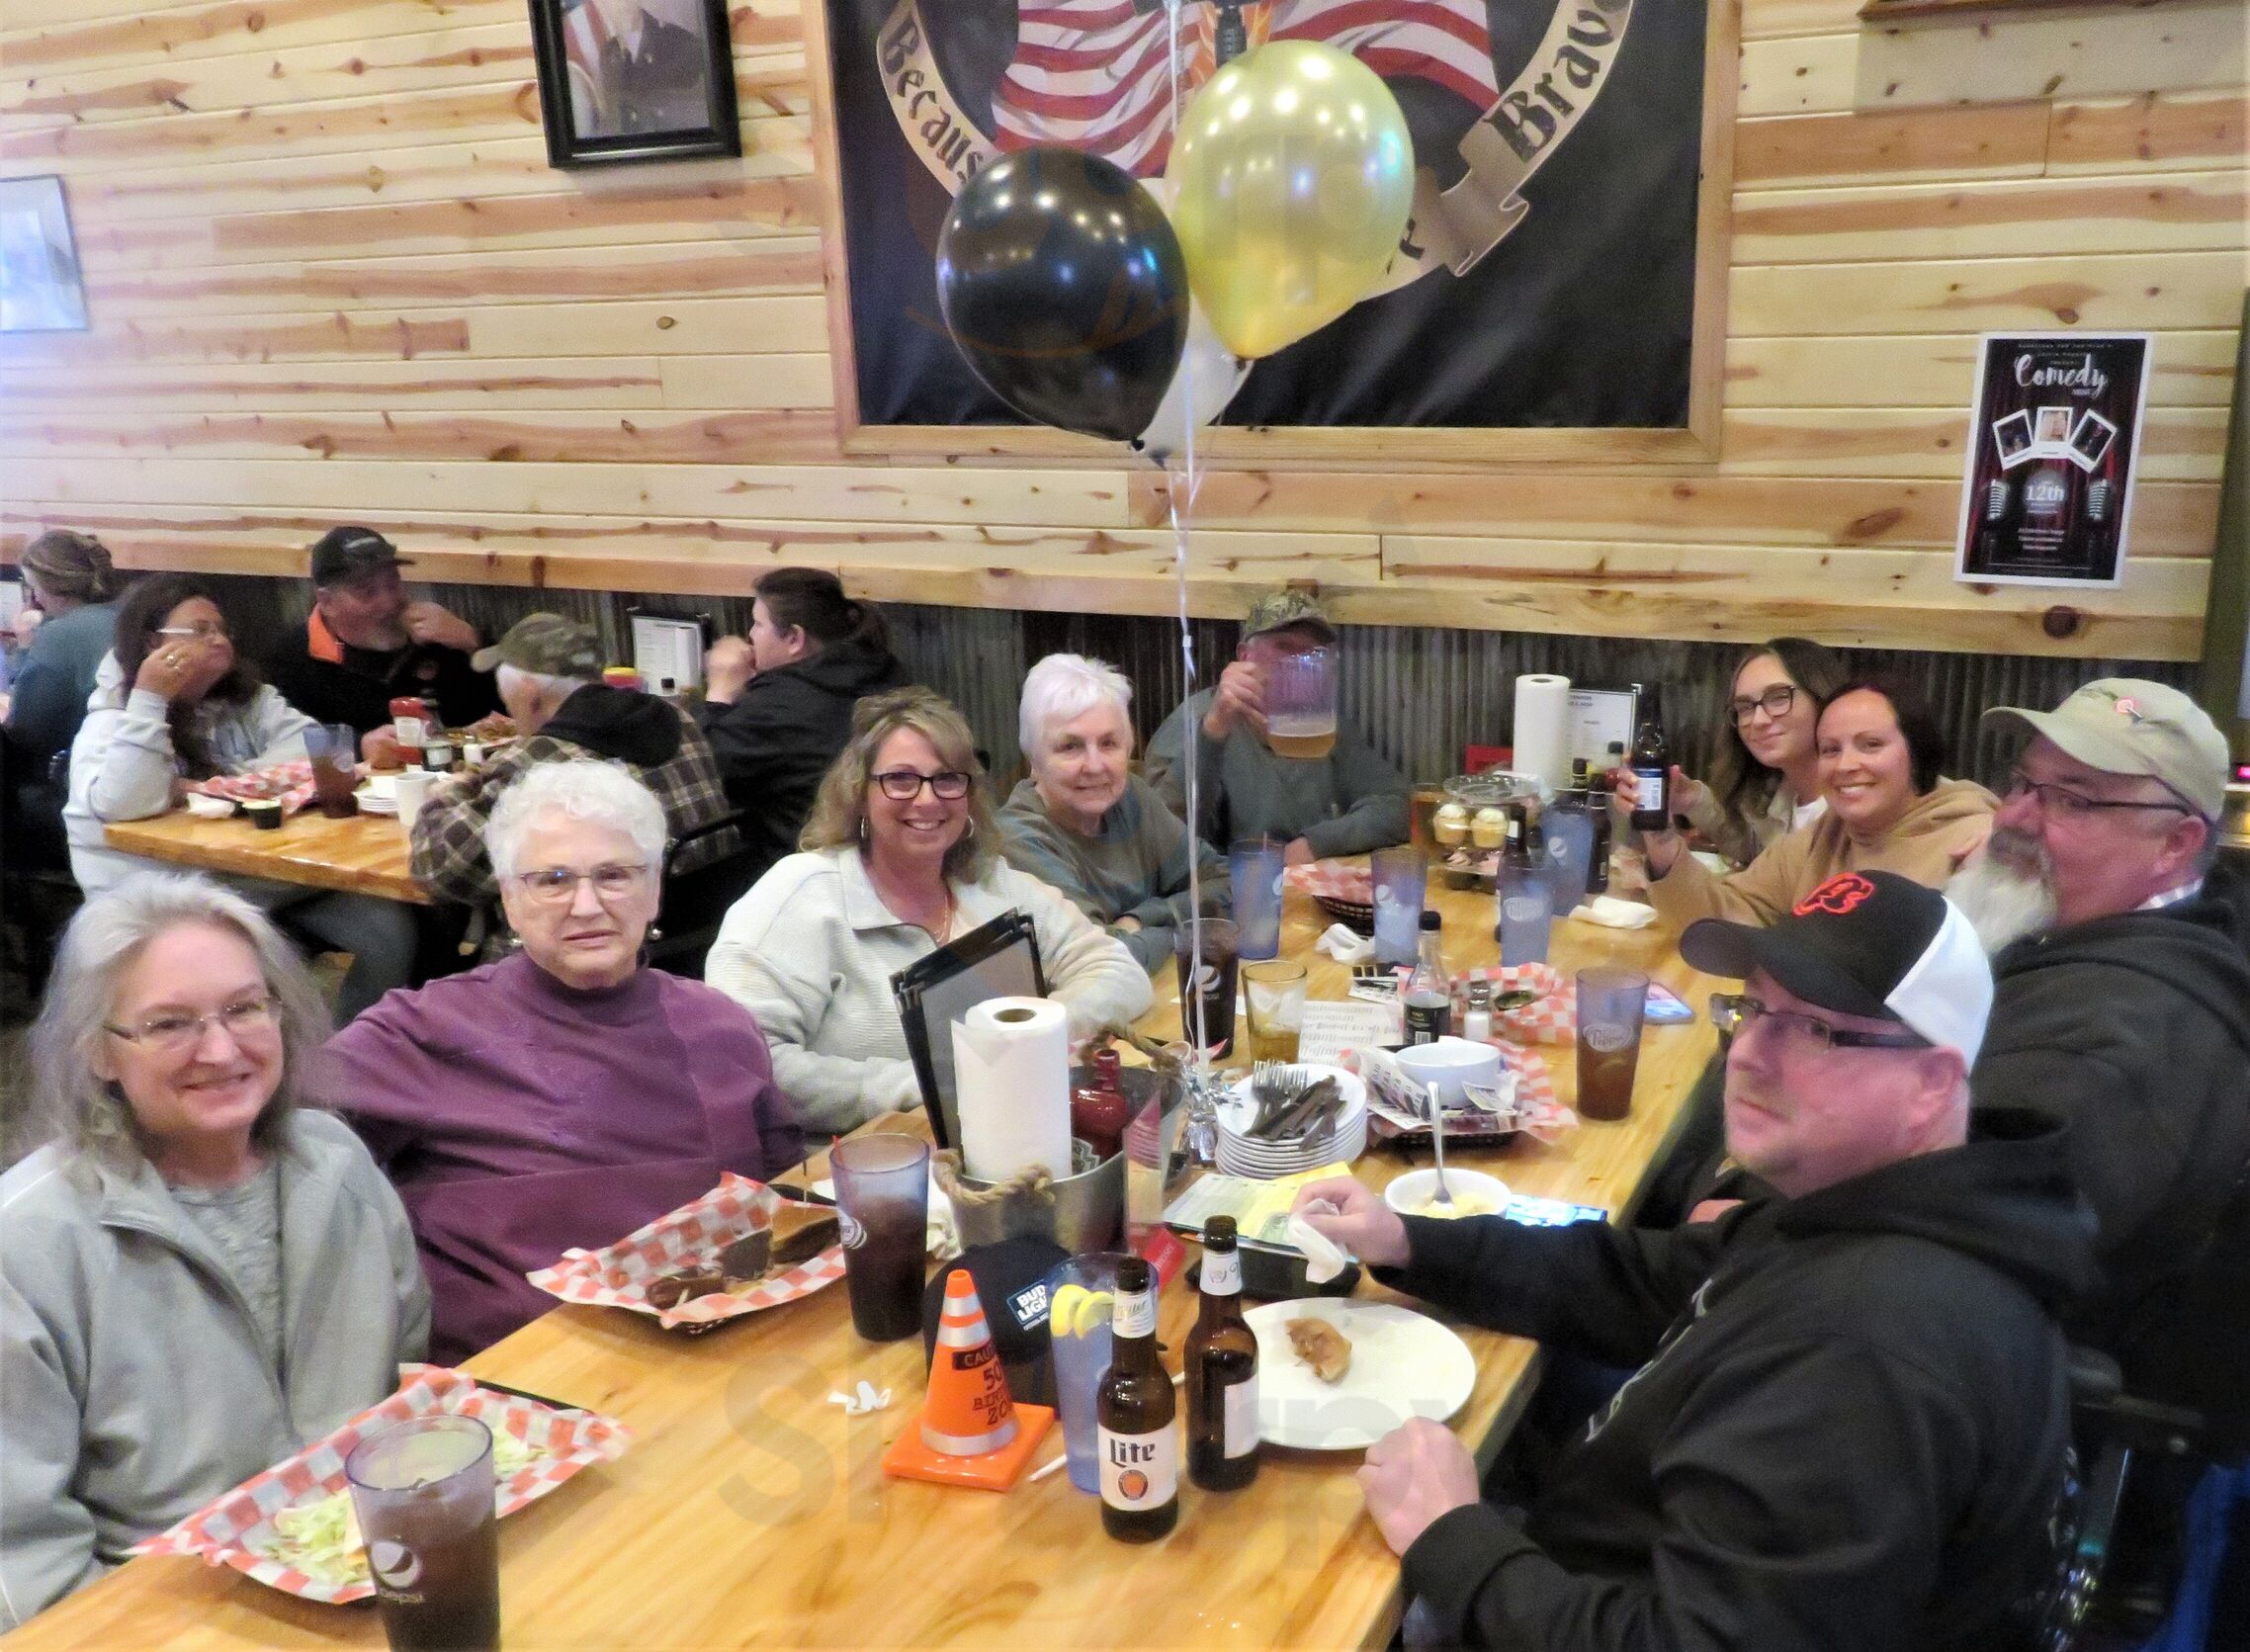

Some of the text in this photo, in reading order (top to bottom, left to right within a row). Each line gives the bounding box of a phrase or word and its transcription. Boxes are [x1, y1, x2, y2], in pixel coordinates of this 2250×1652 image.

[1483, 0, 1627, 164] Brav
[883, 14, 984, 185] Becaus
[2014, 353, 2109, 400] Comedy
[1016, 1284, 1046, 1308] BUD
[964, 1342, 995, 1367] CAU
[984, 1361, 1002, 1390] 50
[1109, 1437, 1156, 1468] Lite
